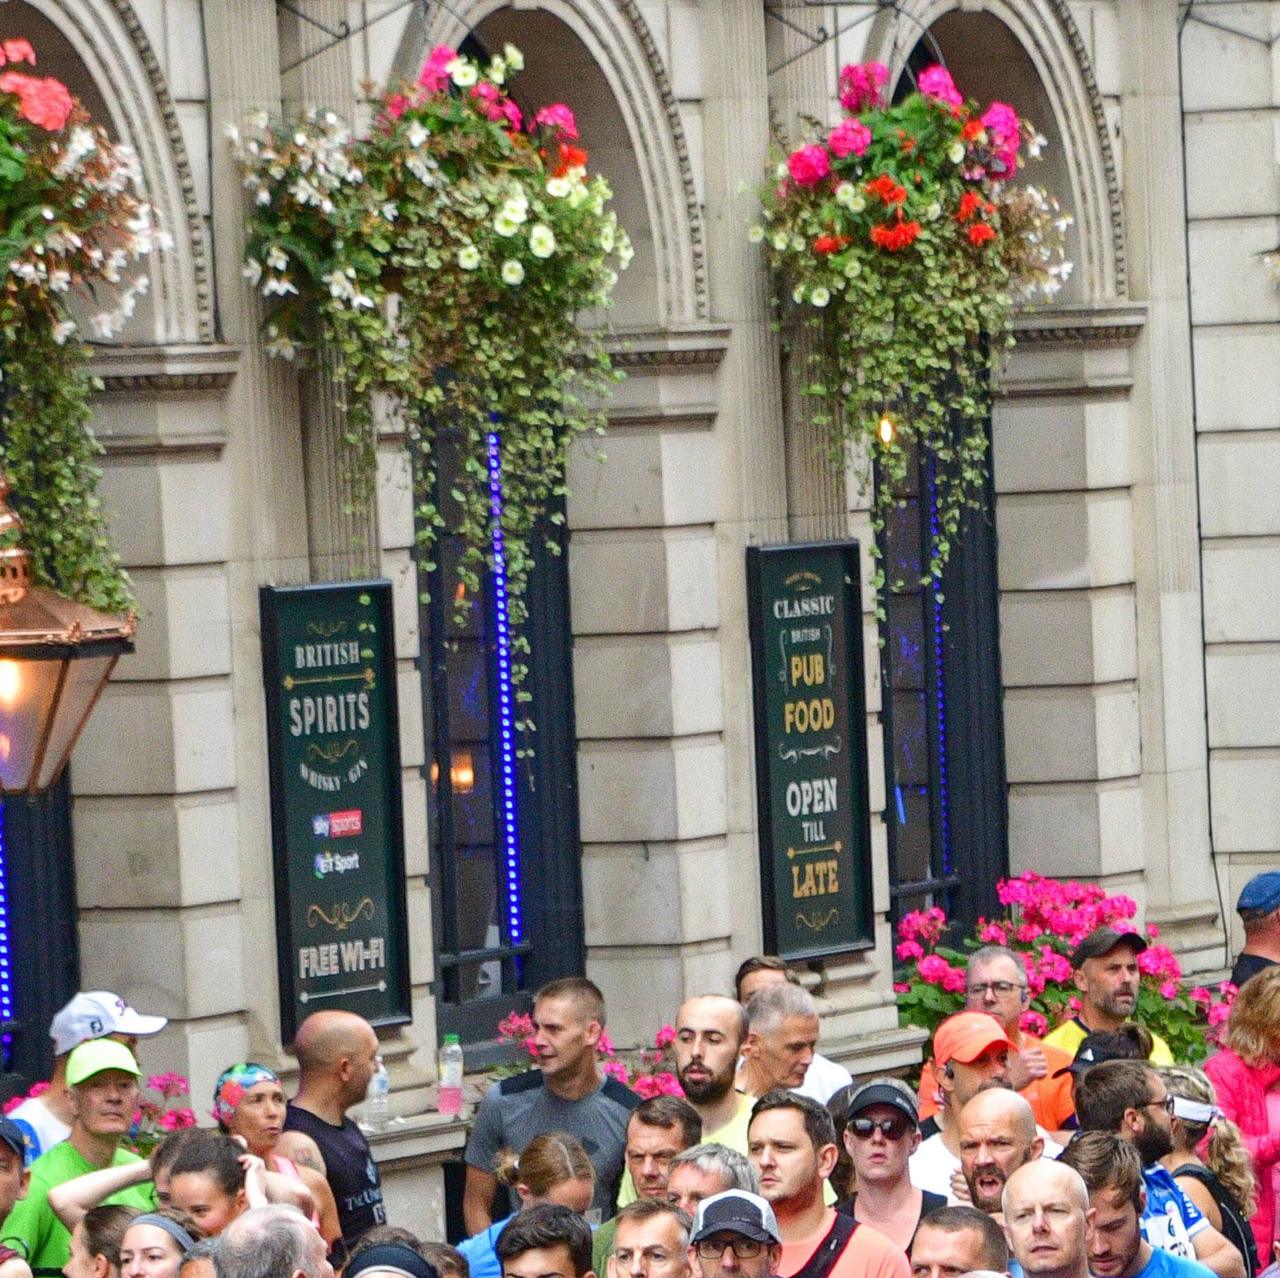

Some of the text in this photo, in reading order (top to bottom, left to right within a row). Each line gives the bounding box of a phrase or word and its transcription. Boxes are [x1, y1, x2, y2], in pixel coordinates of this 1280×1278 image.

[774, 597, 835, 618] CLASSIC
[295, 641, 360, 668] BRITISH
[791, 654, 824, 687] PUB
[290, 693, 369, 737] SPIRITS
[784, 698, 835, 734] FOOD
[786, 777, 838, 817] OPEN
[802, 821, 826, 842] TILL
[792, 860, 839, 898] LATE
[299, 937, 385, 979] FREE WI-FI
